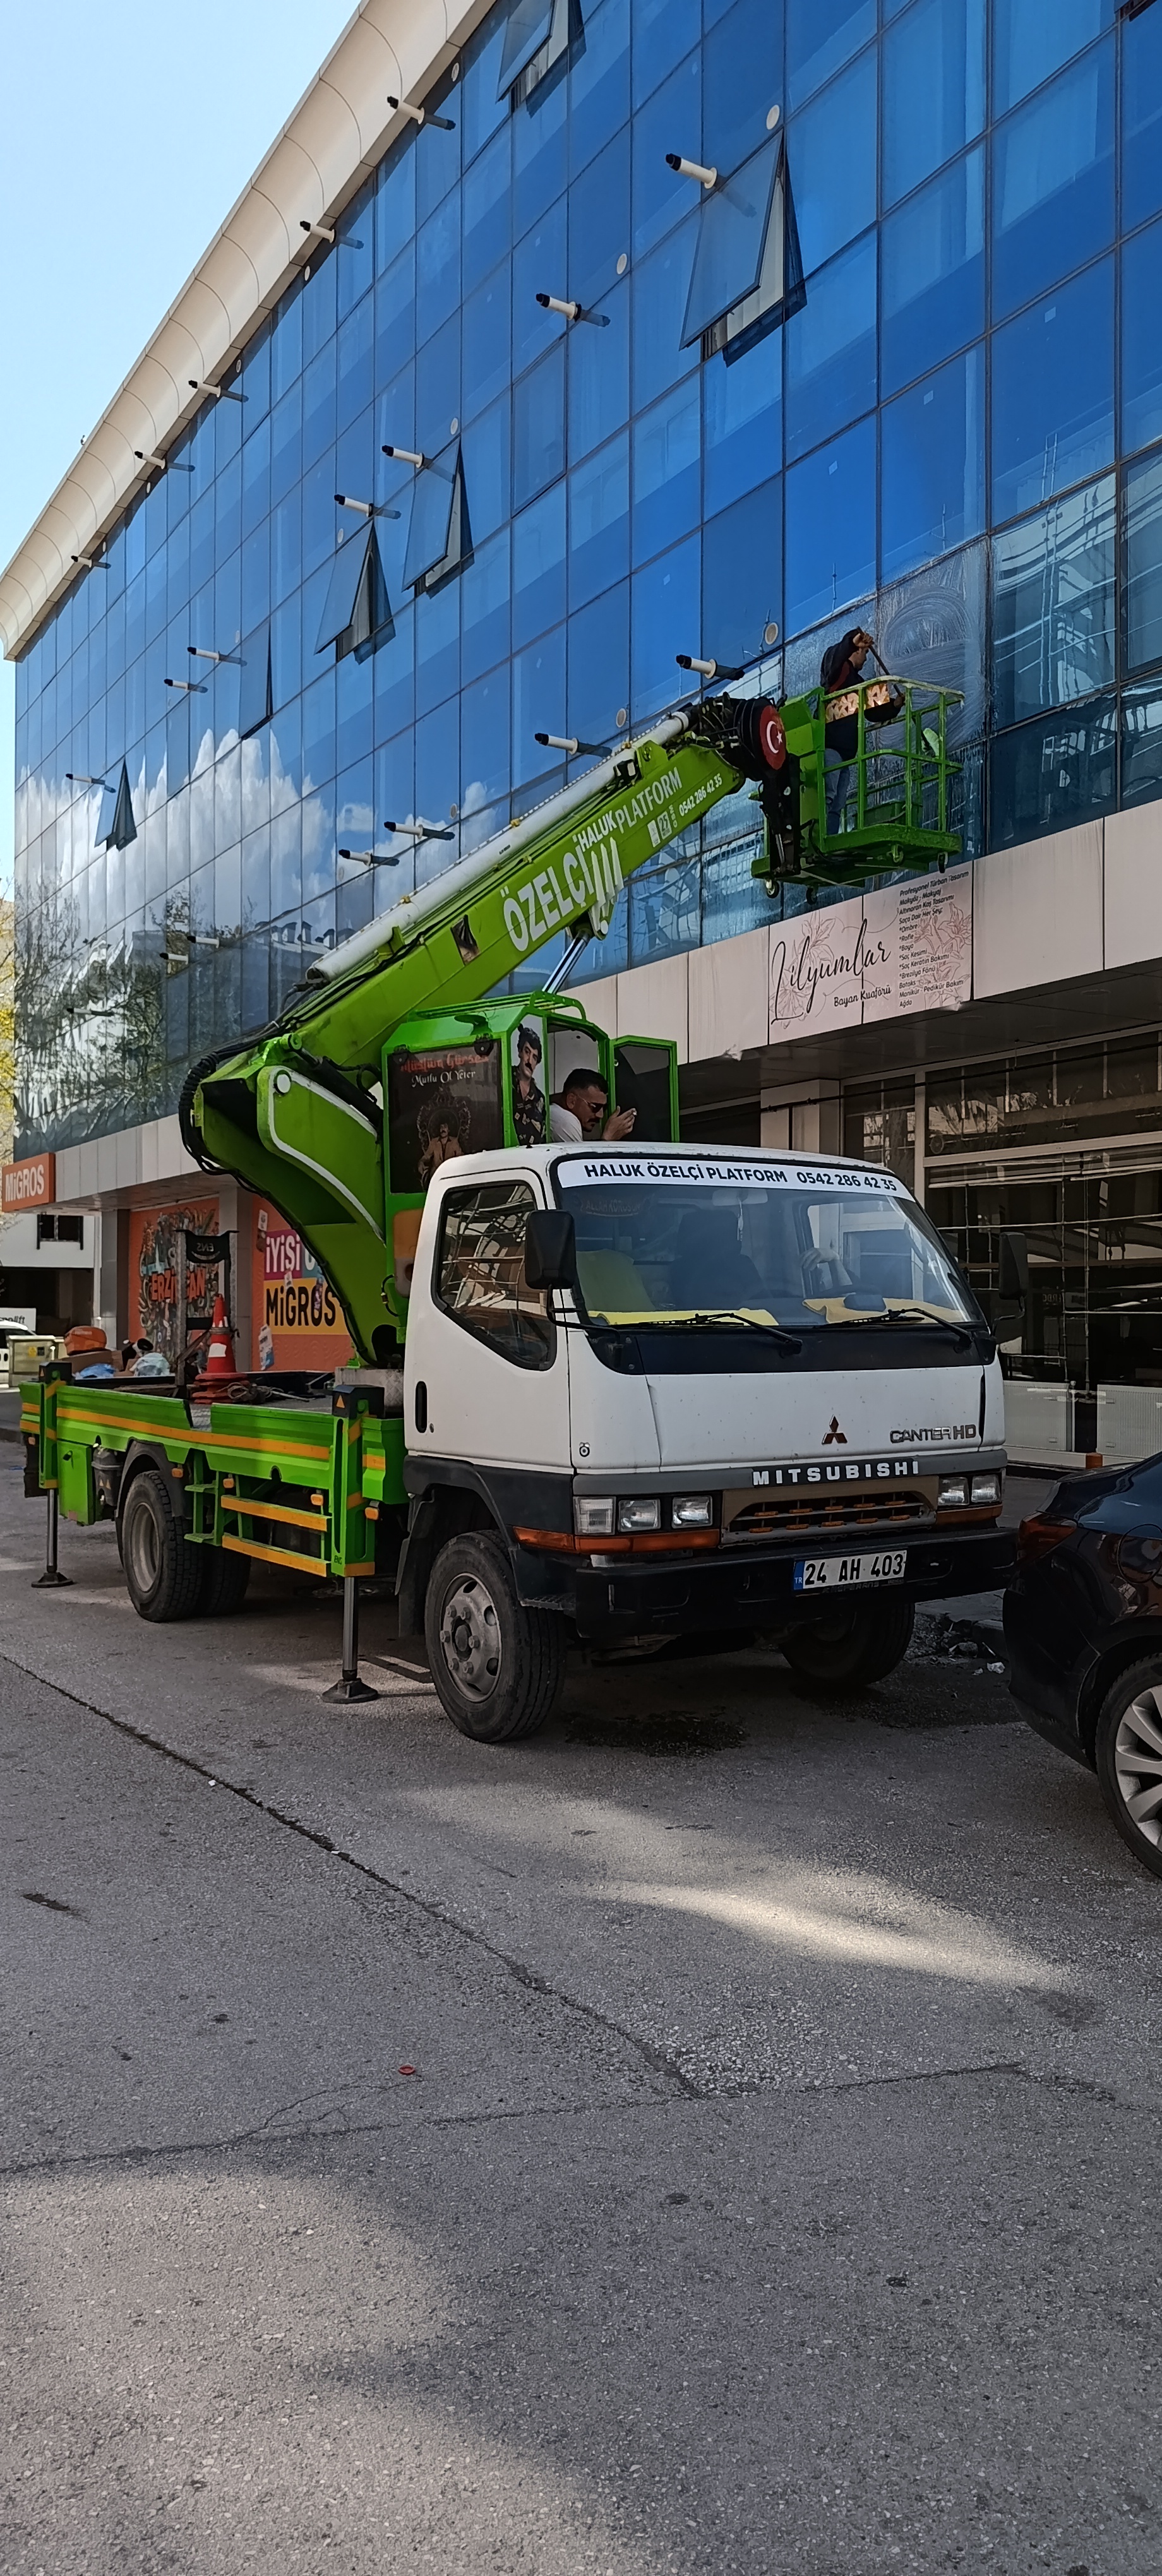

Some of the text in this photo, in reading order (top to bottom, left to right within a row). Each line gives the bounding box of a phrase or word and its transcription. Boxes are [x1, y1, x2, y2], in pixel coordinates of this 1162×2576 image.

[615, 766, 683, 834] PLATFORM
[679, 773, 722, 816] 0542 286 42 35
[577, 810, 617, 852] HALUK
[500, 835, 594, 951] ÖZELÇİ
[899, 883, 929, 897] Profesyonel
[921, 888, 942, 899] Makyaj
[911, 912, 921, 921] Dair
[771, 918, 891, 1025] Lilyumlar
[911, 958, 929, 968] Keratin
[930, 954, 949, 963] Bakımı
[922, 965, 935, 974] Fönü
[834, 985, 892, 1008] Bayan Kuaförü
[899, 987, 919, 998] Manikür
[923, 982, 944, 992] Pedikür
[946, 979, 964, 988] Bakımı
[899, 999, 913, 1008] Ağda
[411, 1070, 476, 1087] Mutlu Ol Yeter
[584, 1162, 897, 1191] HALUK ÖZELÇİ PLATFORM 0542 286 42 35
[890, 1424, 976, 1443] CANTER HD
[753, 1460, 919, 1486] MITSUBISHI
[805, 1553, 903, 1586] 24 AH 403
